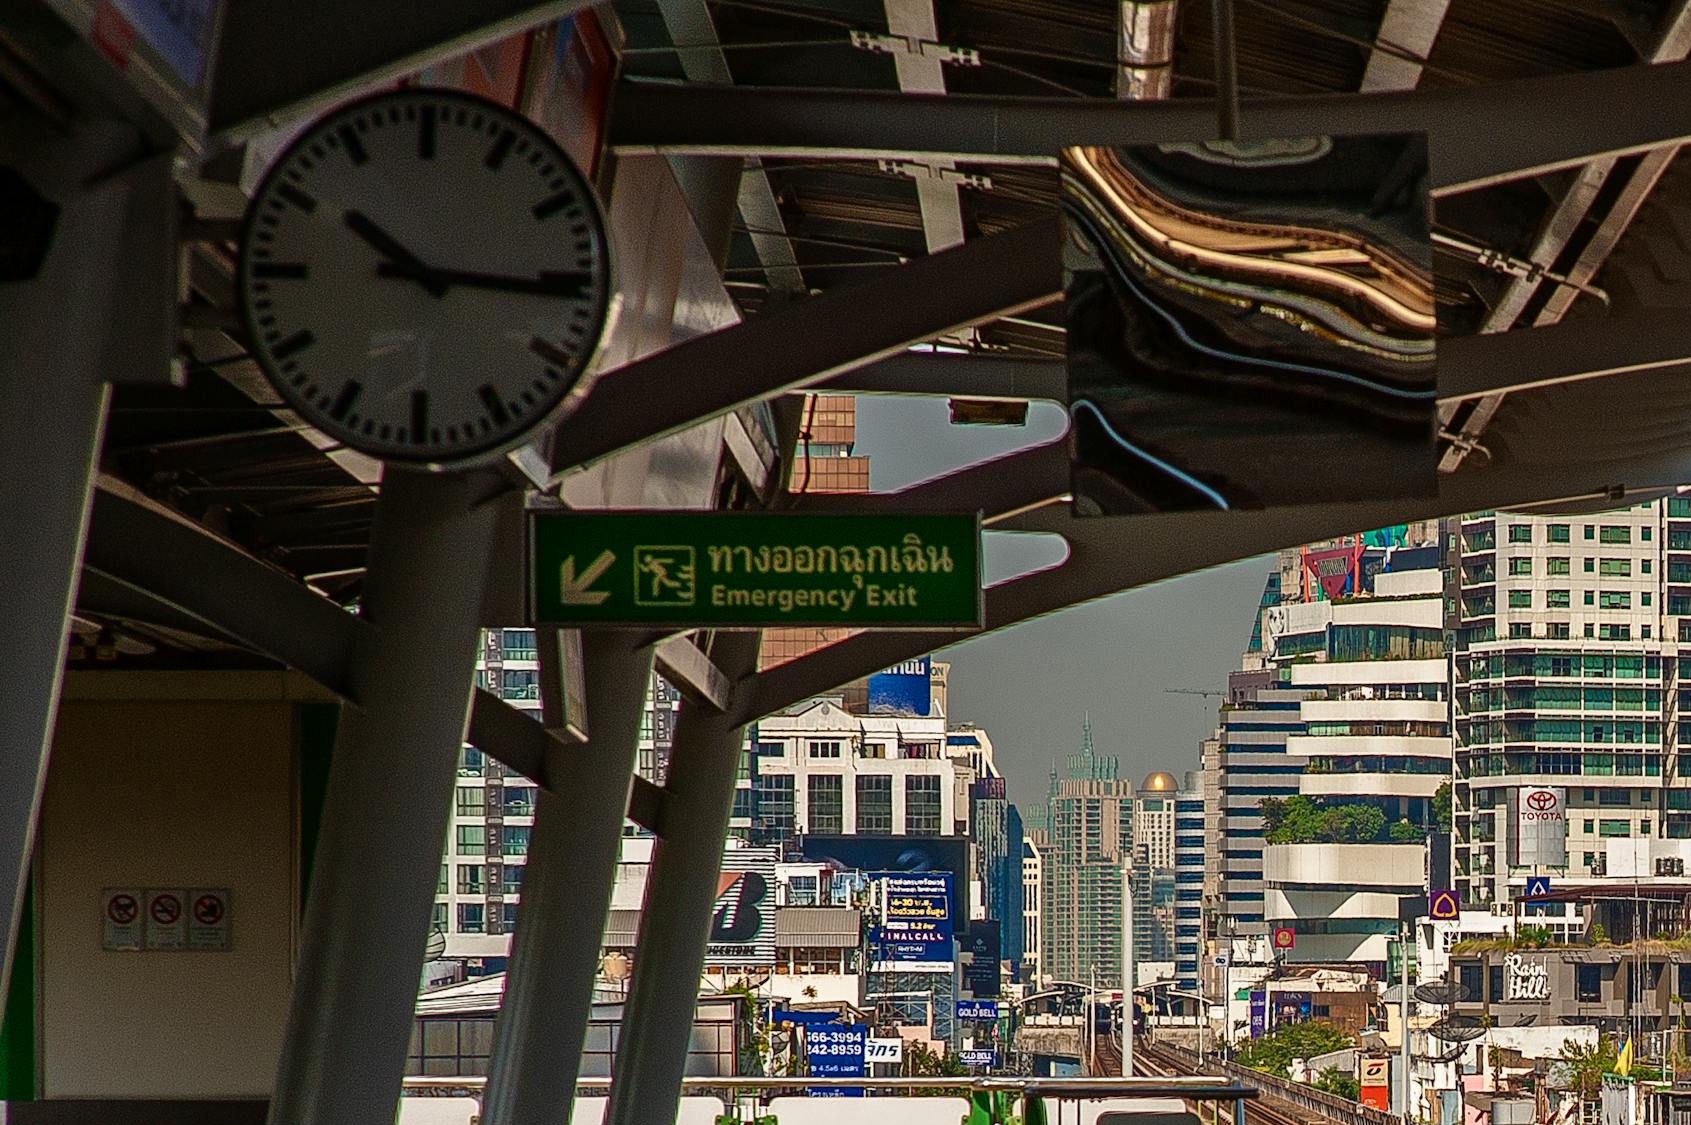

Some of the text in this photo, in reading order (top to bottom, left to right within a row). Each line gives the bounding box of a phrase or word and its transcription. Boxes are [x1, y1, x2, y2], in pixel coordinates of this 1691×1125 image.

[707, 533, 954, 589] ทางออกฉุกเฉิน
[711, 584, 918, 612] Emergency Exit
[1521, 812, 1562, 821] TOYOTA
[958, 1008, 996, 1017] GOLD BELL
